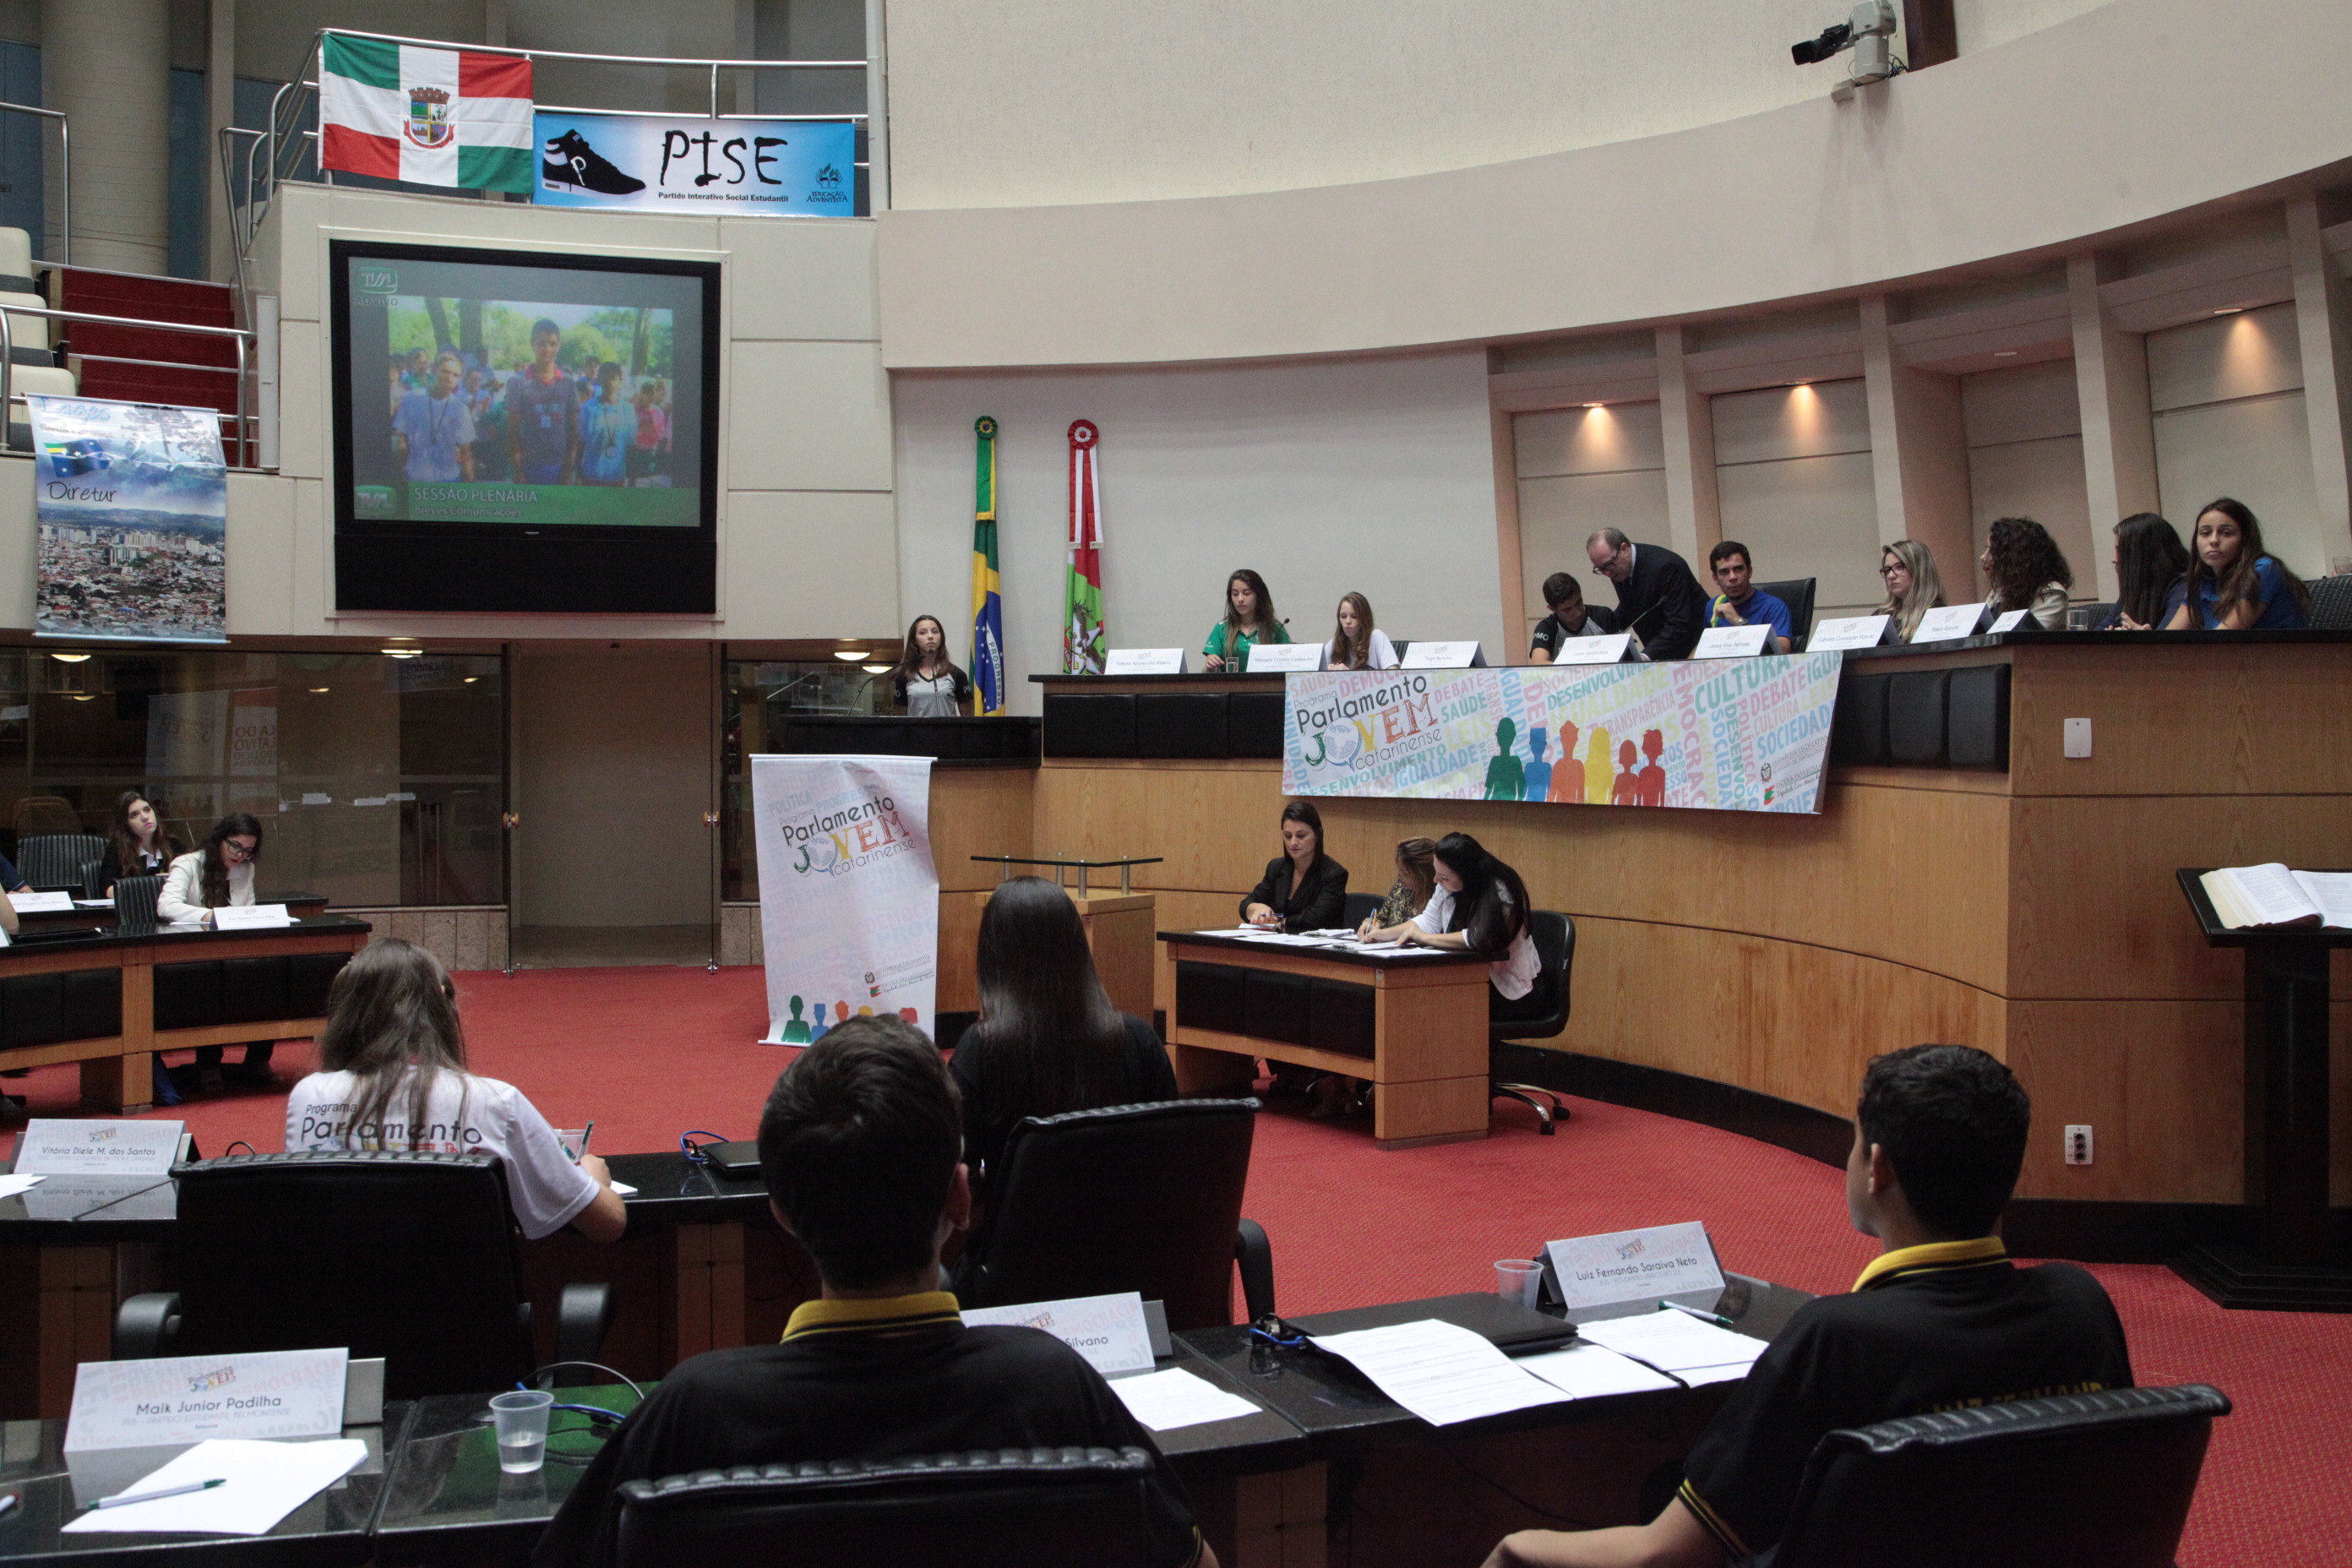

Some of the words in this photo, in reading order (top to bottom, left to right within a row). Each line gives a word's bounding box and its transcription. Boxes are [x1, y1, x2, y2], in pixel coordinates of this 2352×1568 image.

[660, 129, 788, 187] PISE
[688, 193, 724, 201] Interativo
[46, 481, 117, 503] Diretur
[414, 487, 468, 502] SESSÃO
[471, 487, 539, 503] PLENÁRIA
[1293, 689, 1338, 710] Programa
[1434, 672, 1484, 705] DEBATE
[1750, 665, 1807, 719] DEBATE
[1296, 674, 1428, 735] Parlamento
[1440, 690, 1489, 724] SAÚDE
[1354, 727, 1442, 770] catarinense
[1392, 743, 1479, 790] IGUALDADE
[778, 808, 816, 826] Programa
[781, 795, 896, 848] Parlamento
[833, 837, 917, 876] catarinense
[305, 1102, 358, 1115] Programa
[42, 1146, 70, 1155] Vitória
[74, 1146, 94, 1155] Diele
[109, 1147, 125, 1156] dos
[127, 1147, 156, 1156] Santos
[1576, 1268, 1596, 1281] Luiz
[1595, 1265, 1639, 1278] Fernando
[1640, 1260, 1675, 1274] Saraiva
[1676, 1255, 1698, 1267] Neto
[1064, 1337, 1109, 1349] Silvano
[136, 1402, 172, 1416] Maik
[177, 1399, 221, 1413] Junior
[226, 1395, 282, 1410] Padilha
